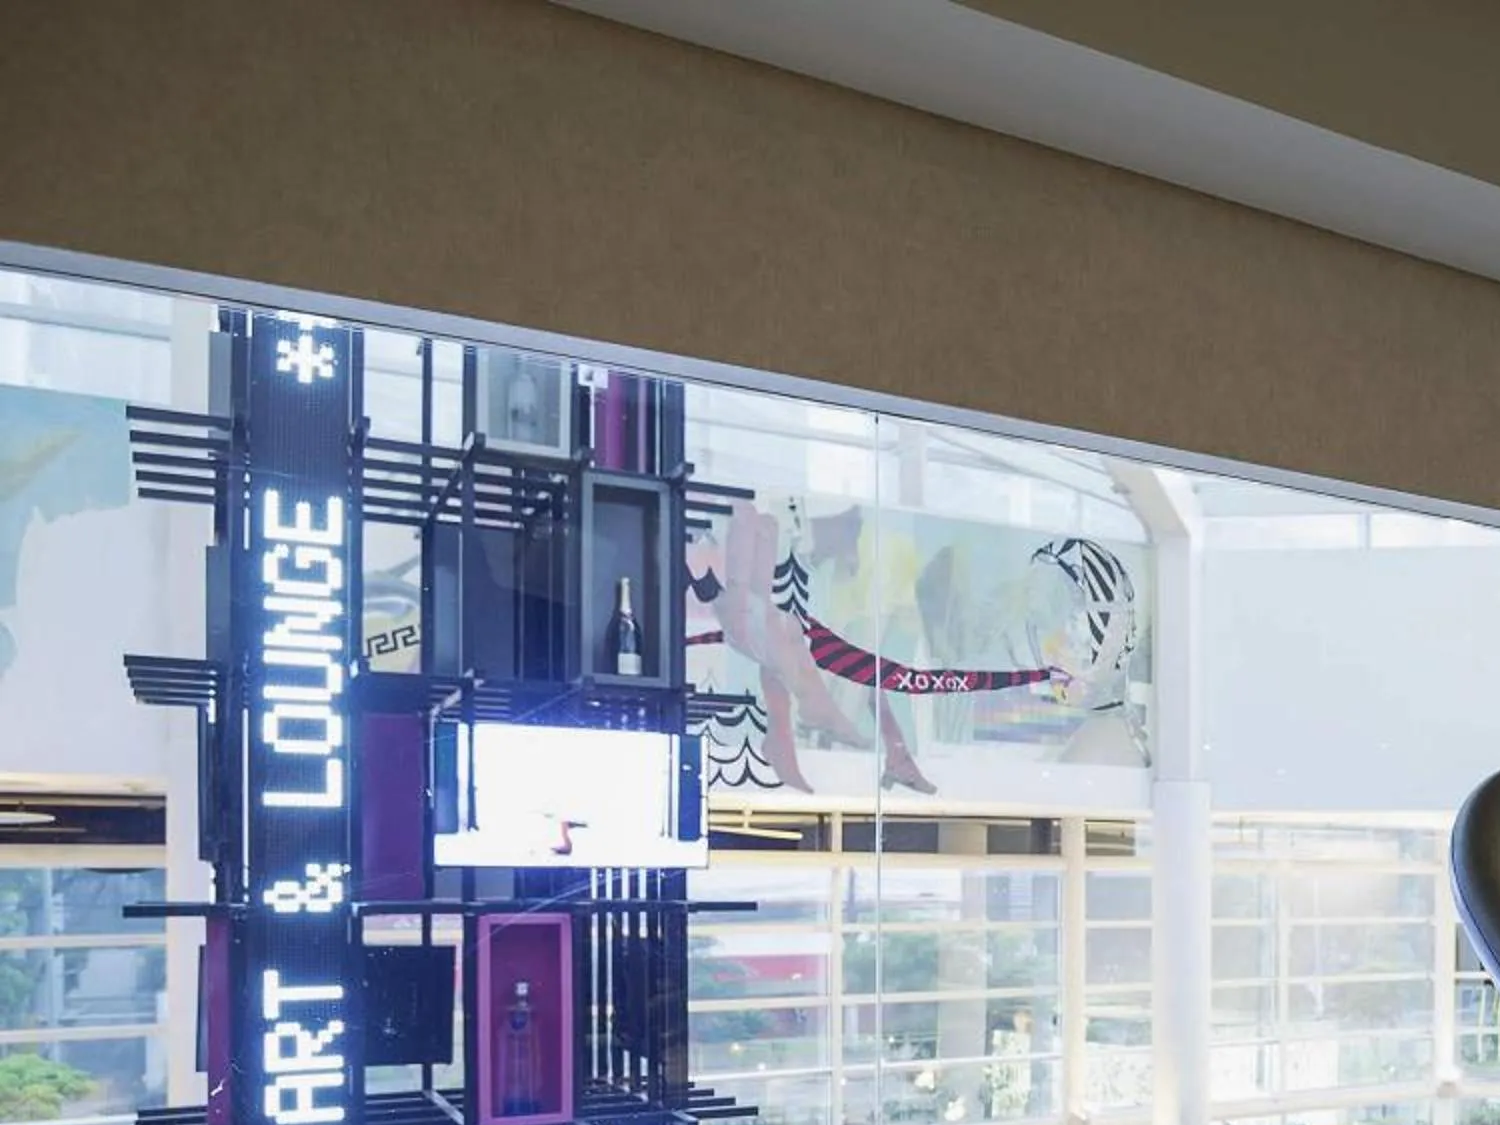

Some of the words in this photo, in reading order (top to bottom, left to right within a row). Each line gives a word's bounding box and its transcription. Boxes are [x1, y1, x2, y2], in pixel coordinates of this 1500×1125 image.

[262, 488, 343, 807] LOUNGE
[263, 862, 344, 913] &
[264, 969, 345, 1125] ART
